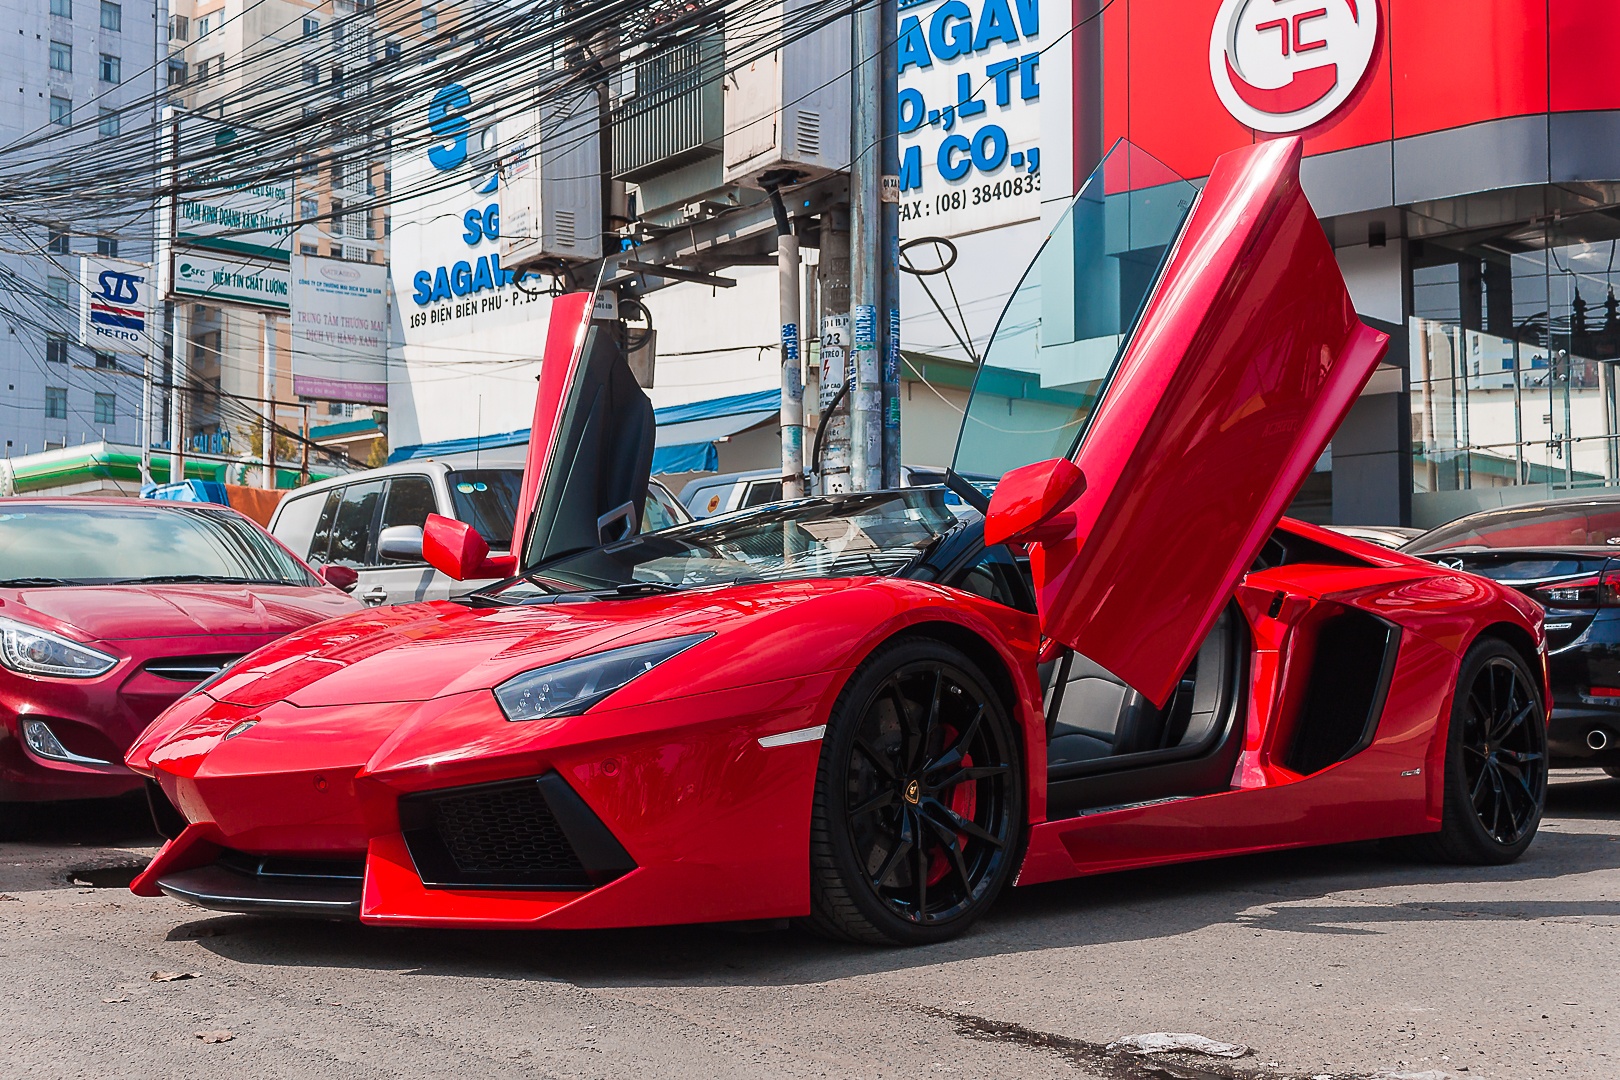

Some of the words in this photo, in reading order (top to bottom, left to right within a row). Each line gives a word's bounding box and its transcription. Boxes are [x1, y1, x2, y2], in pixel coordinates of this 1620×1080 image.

[936, 189, 967, 215] (08)
[190, 268, 205, 277] SFC
[232, 273, 244, 289] TIN
[297, 311, 321, 325] TRUNG
[323, 312, 339, 327] TÂM
[410, 312, 427, 329] 169
[430, 304, 452, 325] ĐIỆN
[455, 299, 478, 319] BIÊN
[95, 326, 139, 342] PETRO
